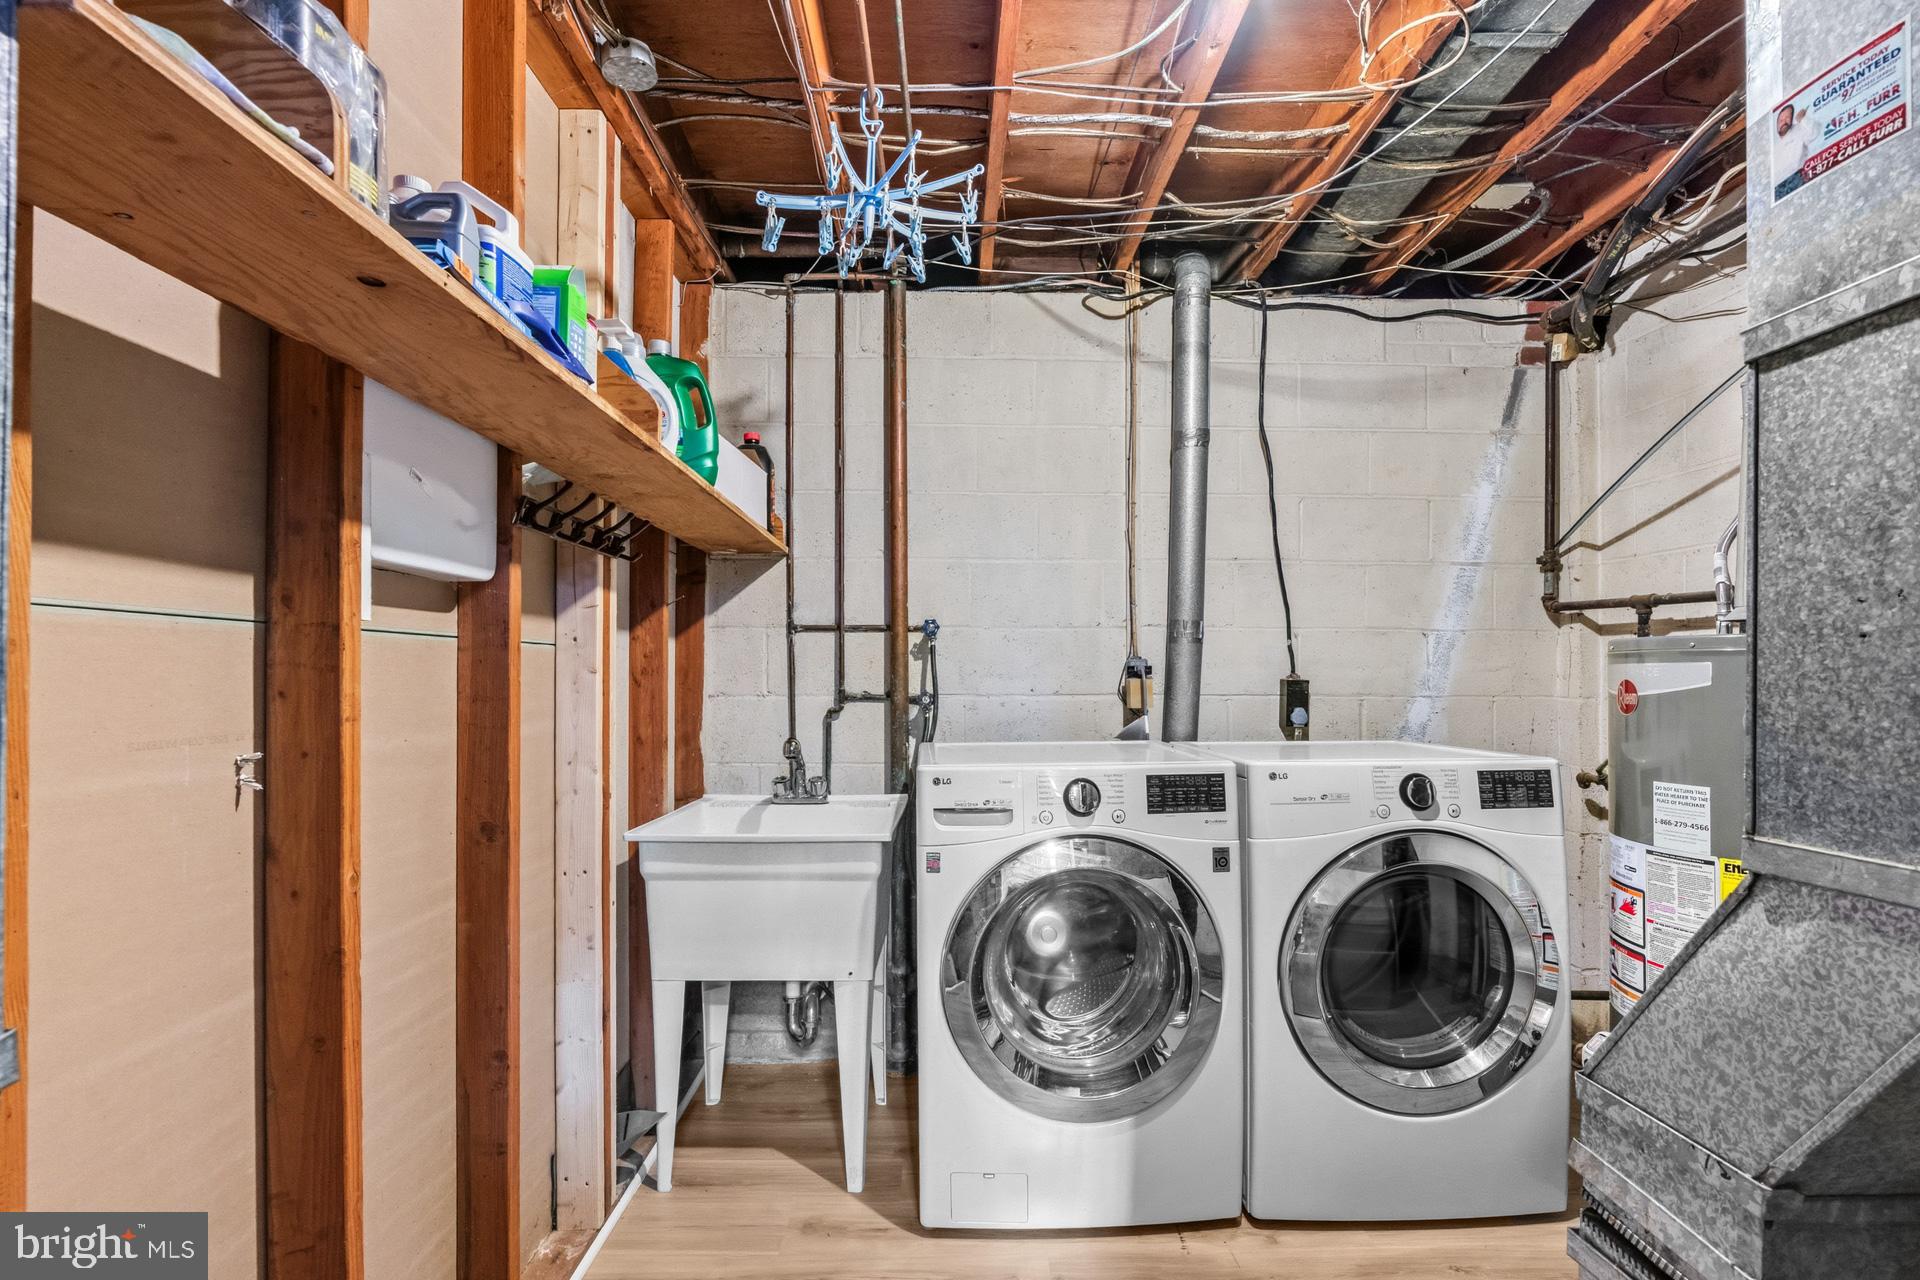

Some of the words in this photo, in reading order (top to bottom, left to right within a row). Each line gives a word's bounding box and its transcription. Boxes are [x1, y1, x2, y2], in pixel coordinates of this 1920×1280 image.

[1812, 47, 1902, 107] GUARANTEED
[1821, 66, 1857, 92] SERVICE
[1858, 44, 1890, 68] TODAY
[1866, 84, 1901, 111] FURR
[1804, 156, 1822, 171] CALL
[1822, 146, 1838, 162] FOR
[1839, 128, 1872, 151] SERVICE
[1873, 108, 1904, 131] TODAY
[1807, 138, 1867, 179] 1-877-CALL
[1868, 117, 1903, 145] FURR
[942, 777, 952, 785] LG
[1654, 817, 1710, 832] 1-866-279-4566
